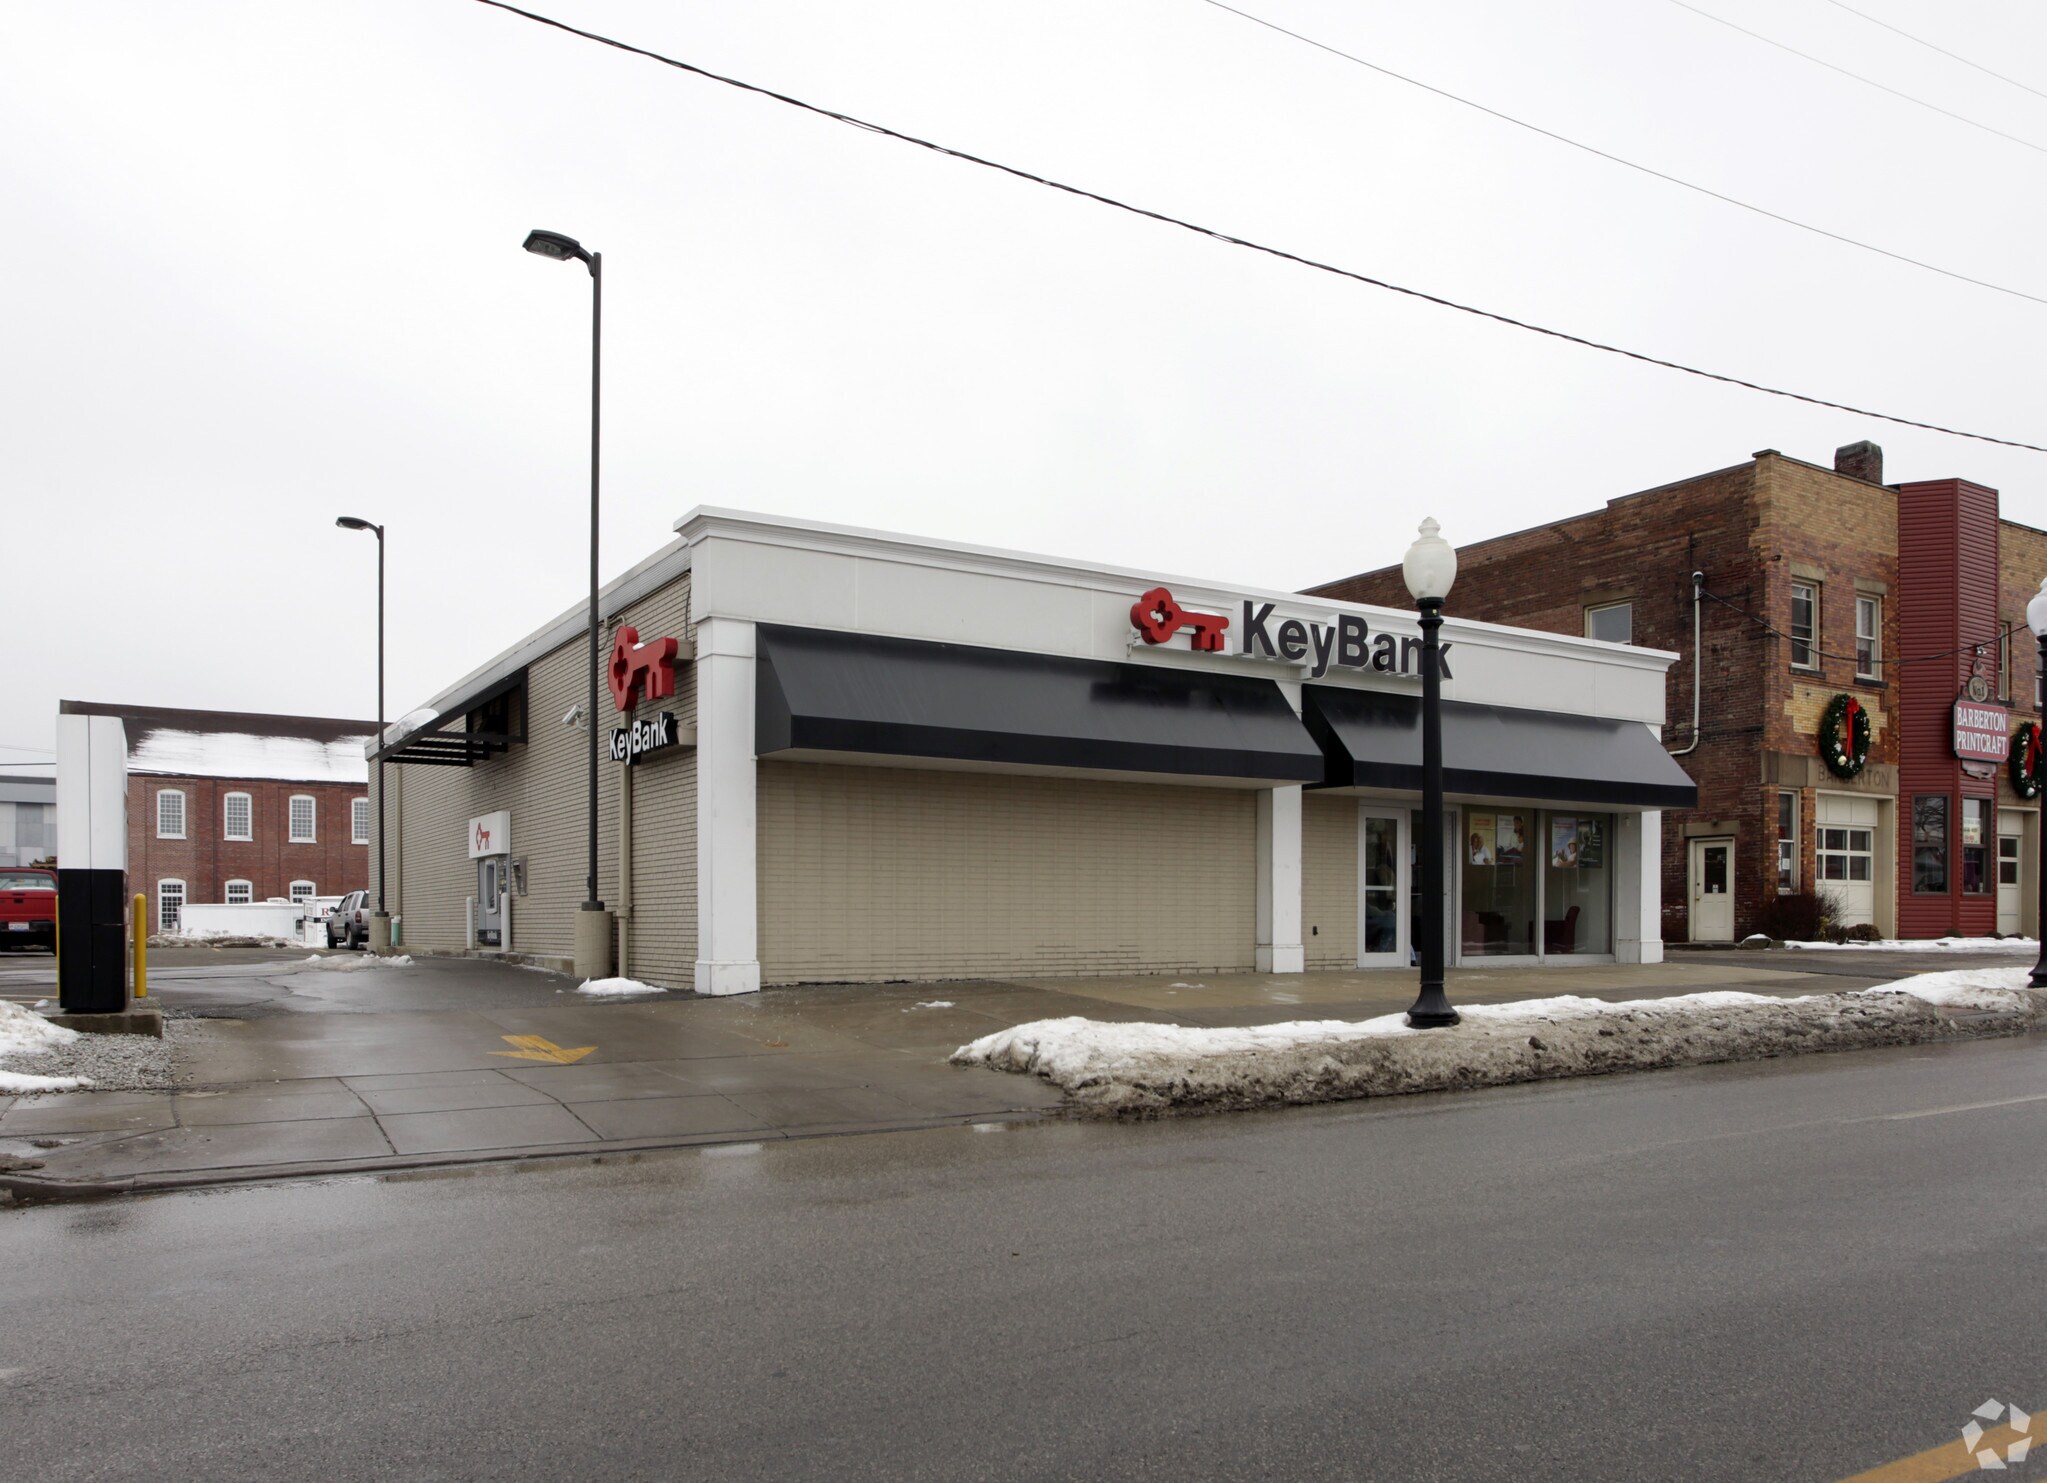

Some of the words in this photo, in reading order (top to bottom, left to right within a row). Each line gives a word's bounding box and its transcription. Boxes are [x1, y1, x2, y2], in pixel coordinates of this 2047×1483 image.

[1243, 600, 1453, 679] KeyBank
[609, 711, 668, 766] KeyBank
[1956, 706, 2007, 732] BARBERTON
[1956, 730, 2007, 755] PRINTCRAFT
